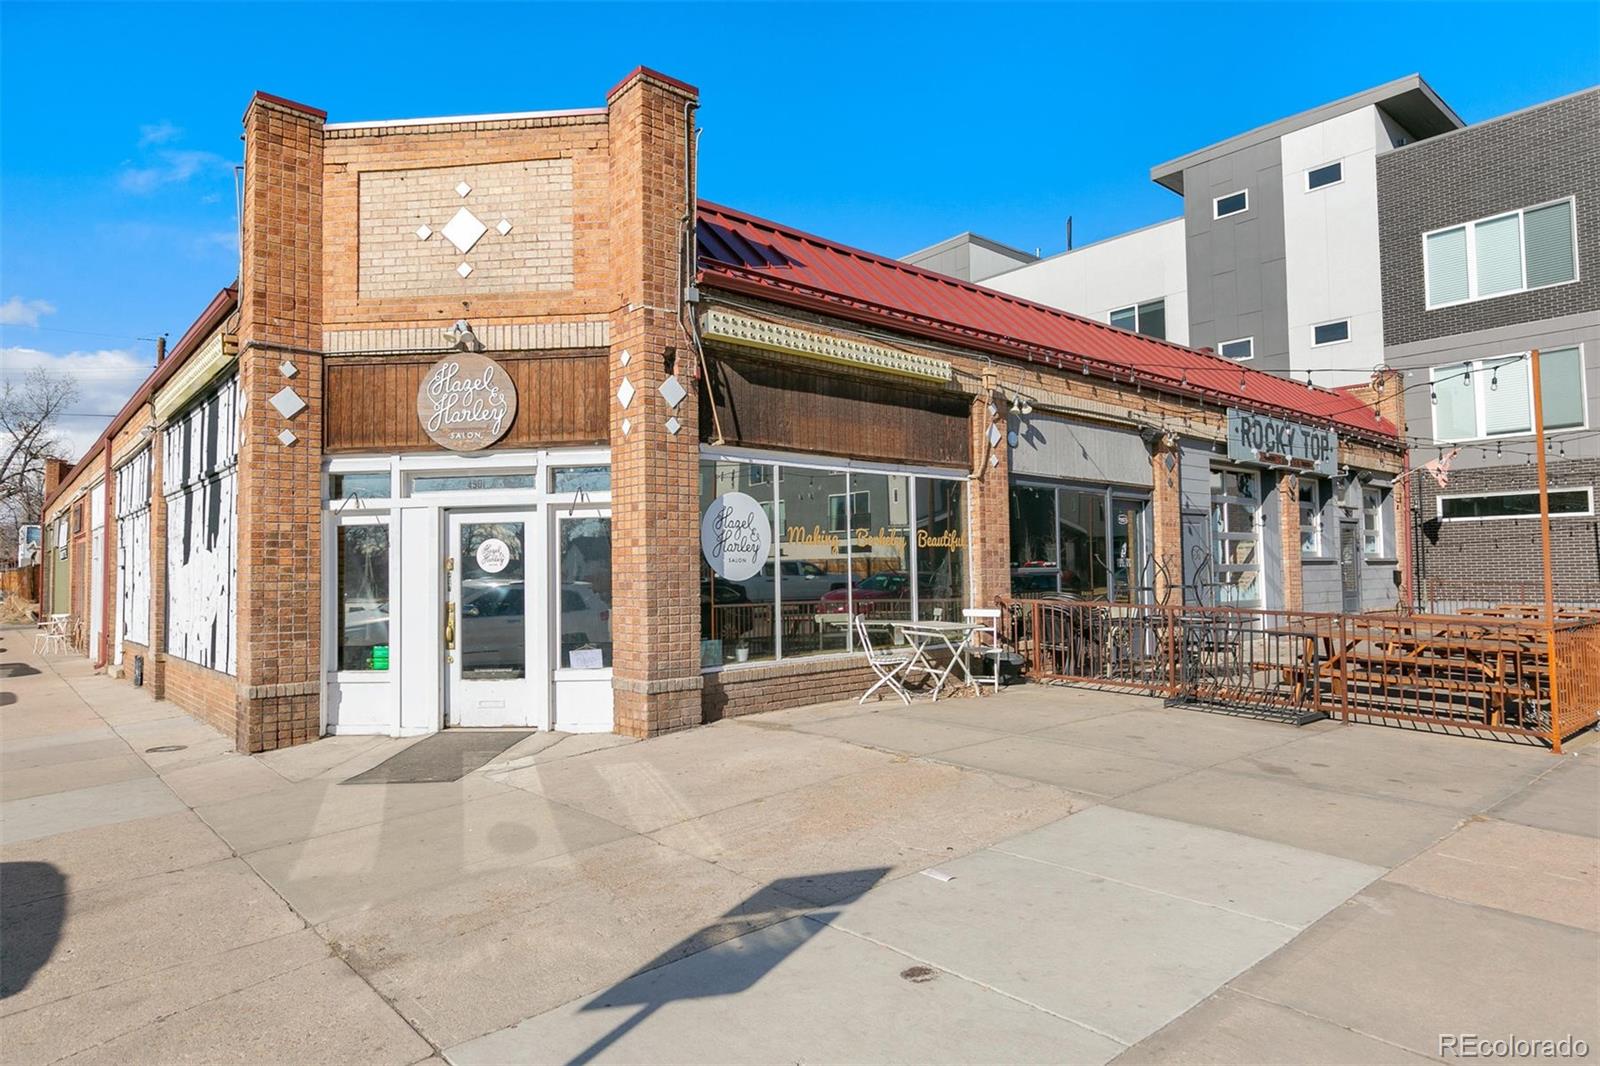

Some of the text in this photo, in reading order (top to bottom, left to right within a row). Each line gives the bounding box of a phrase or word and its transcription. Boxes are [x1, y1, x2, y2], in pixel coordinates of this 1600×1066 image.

[427, 363, 493, 407] Hazel
[427, 393, 507, 435] Harley
[1240, 416, 1330, 462] ROCKY TOP
[713, 506, 755, 541] Hazel
[787, 525, 840, 556] Making
[917, 529, 969, 552] Beautiful
[712, 529, 761, 563] Harley
